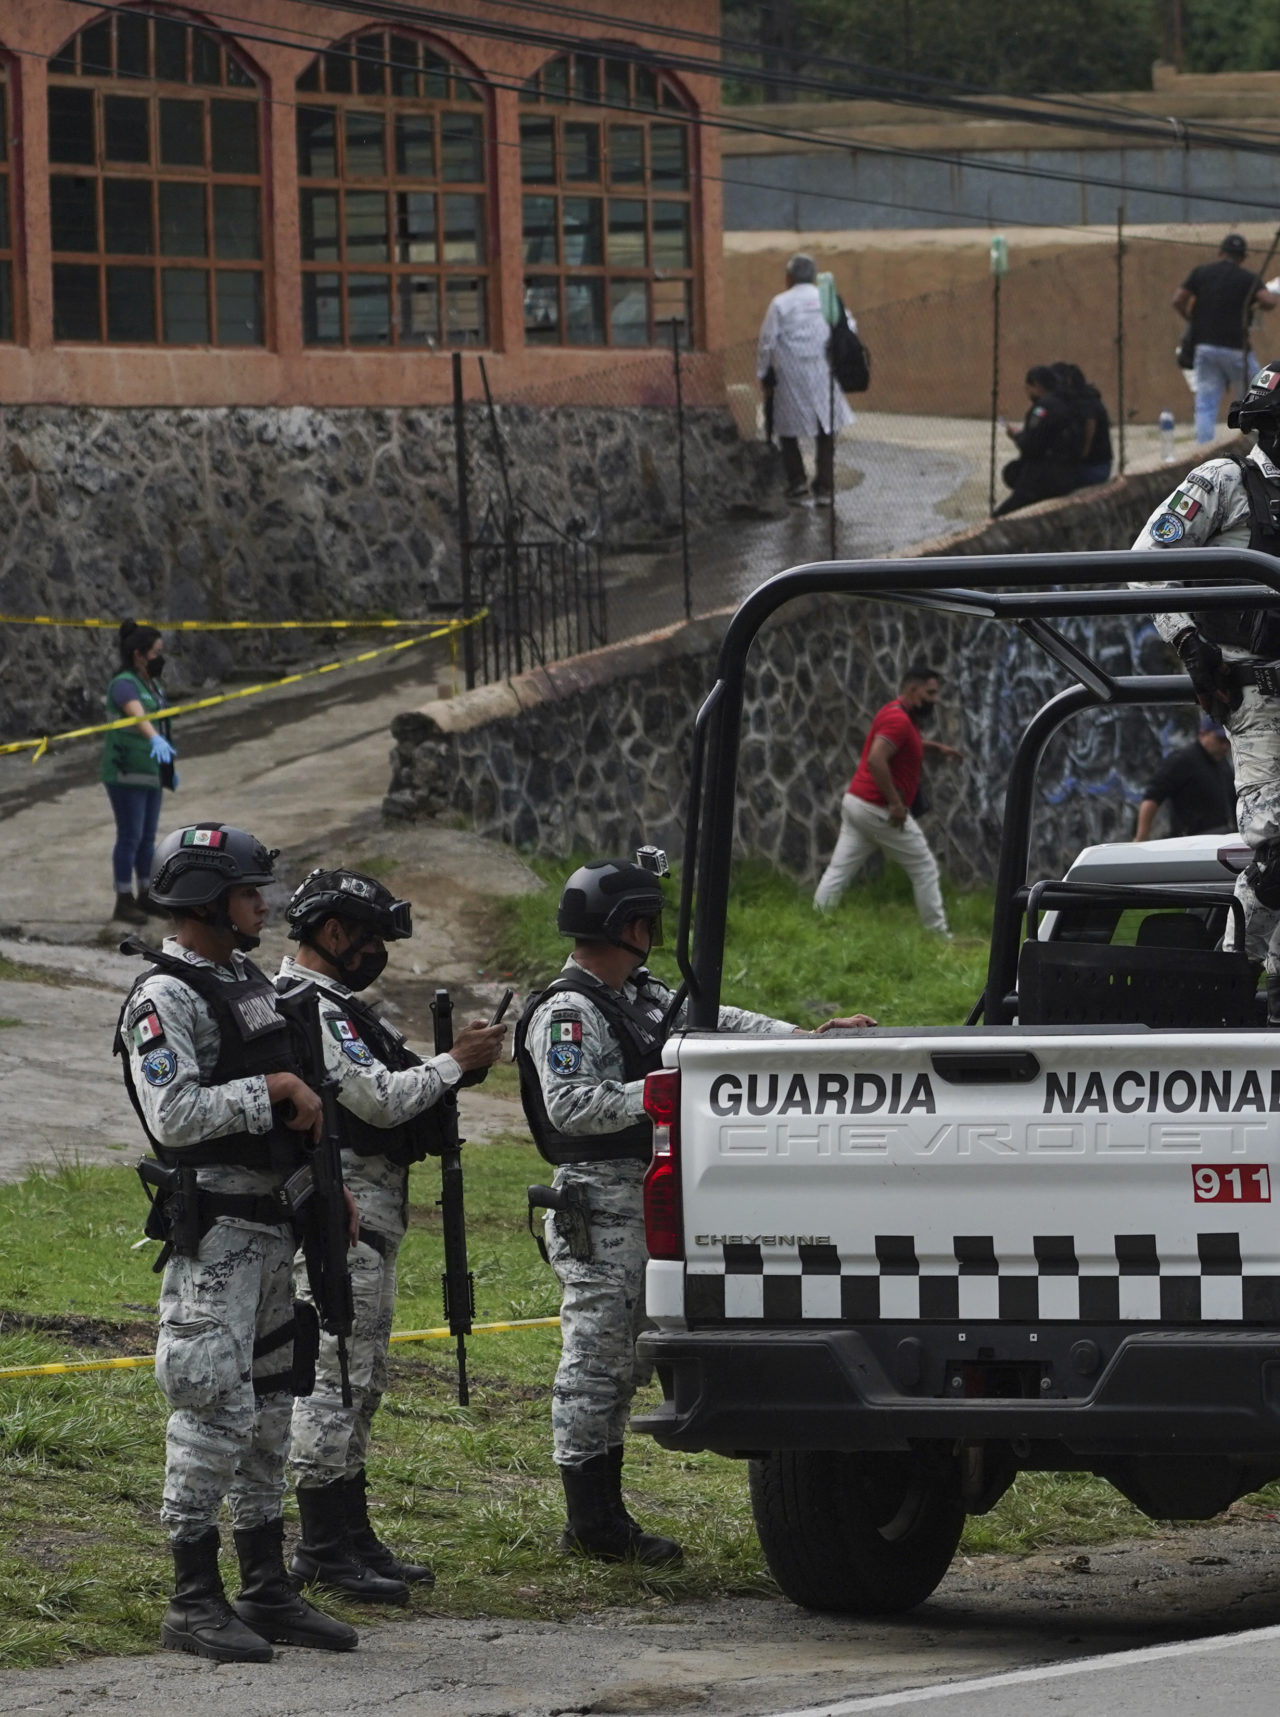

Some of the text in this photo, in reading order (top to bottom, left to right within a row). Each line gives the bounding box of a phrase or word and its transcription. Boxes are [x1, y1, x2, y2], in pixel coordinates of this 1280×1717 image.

[709, 1073, 937, 1117] GUARDIA
[719, 1121, 1268, 1156] CHEVROLET
[1194, 1167, 1270, 1200] 911
[695, 1234, 831, 1247] CHEYENNE
